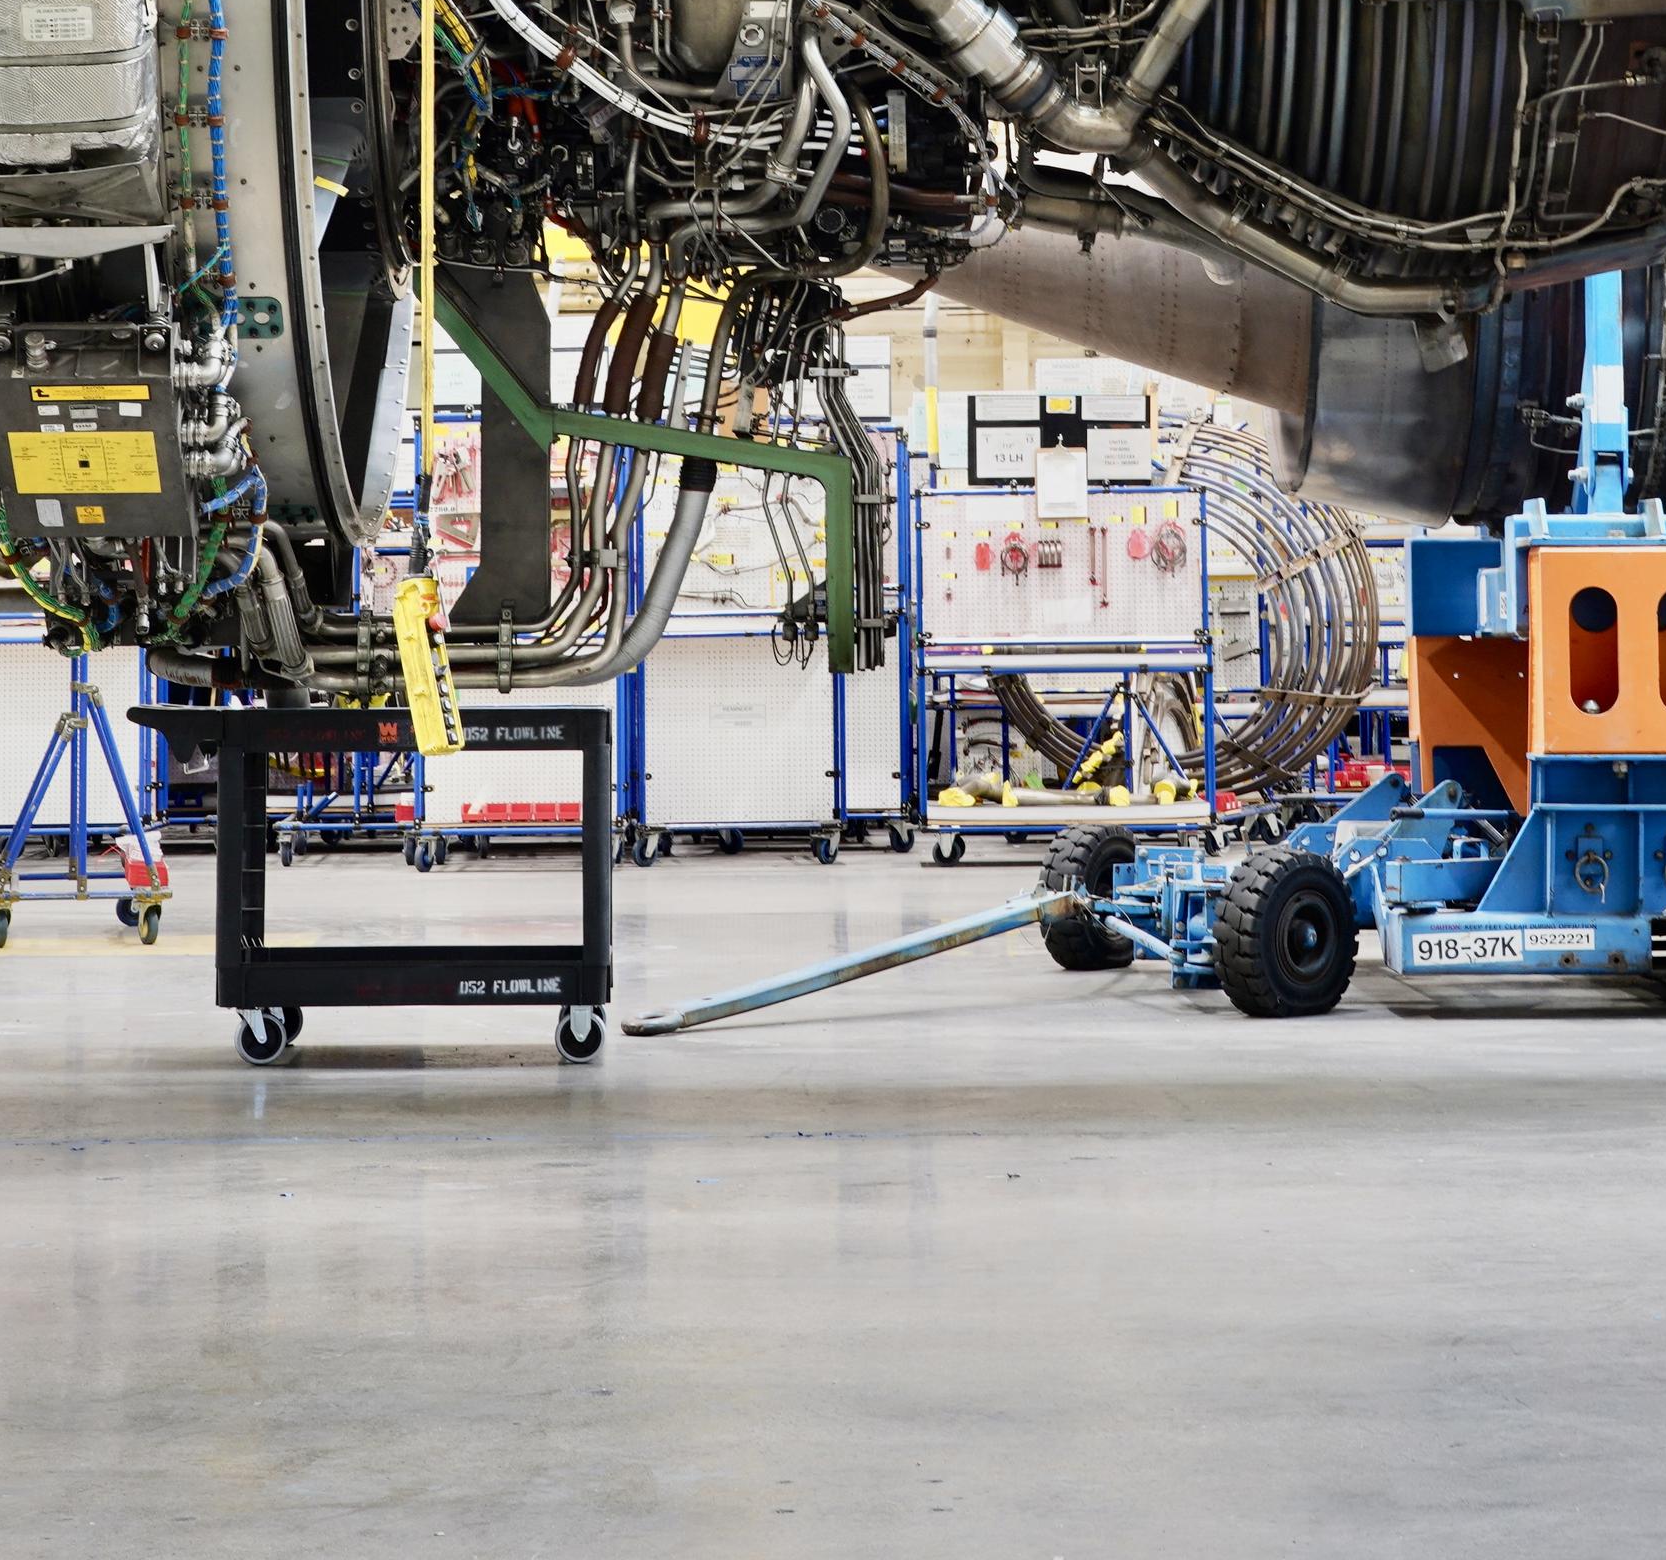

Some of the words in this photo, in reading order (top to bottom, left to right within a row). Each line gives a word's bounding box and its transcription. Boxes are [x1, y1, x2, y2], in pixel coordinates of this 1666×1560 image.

[994, 454, 1006, 462] 13
[1008, 454, 1024, 462] LH
[495, 724, 565, 741] FLOWLINE
[1529, 932, 1591, 945] 9522221
[1418, 936, 1518, 961] 918-37K
[492, 976, 562, 993] FLOWLINE
